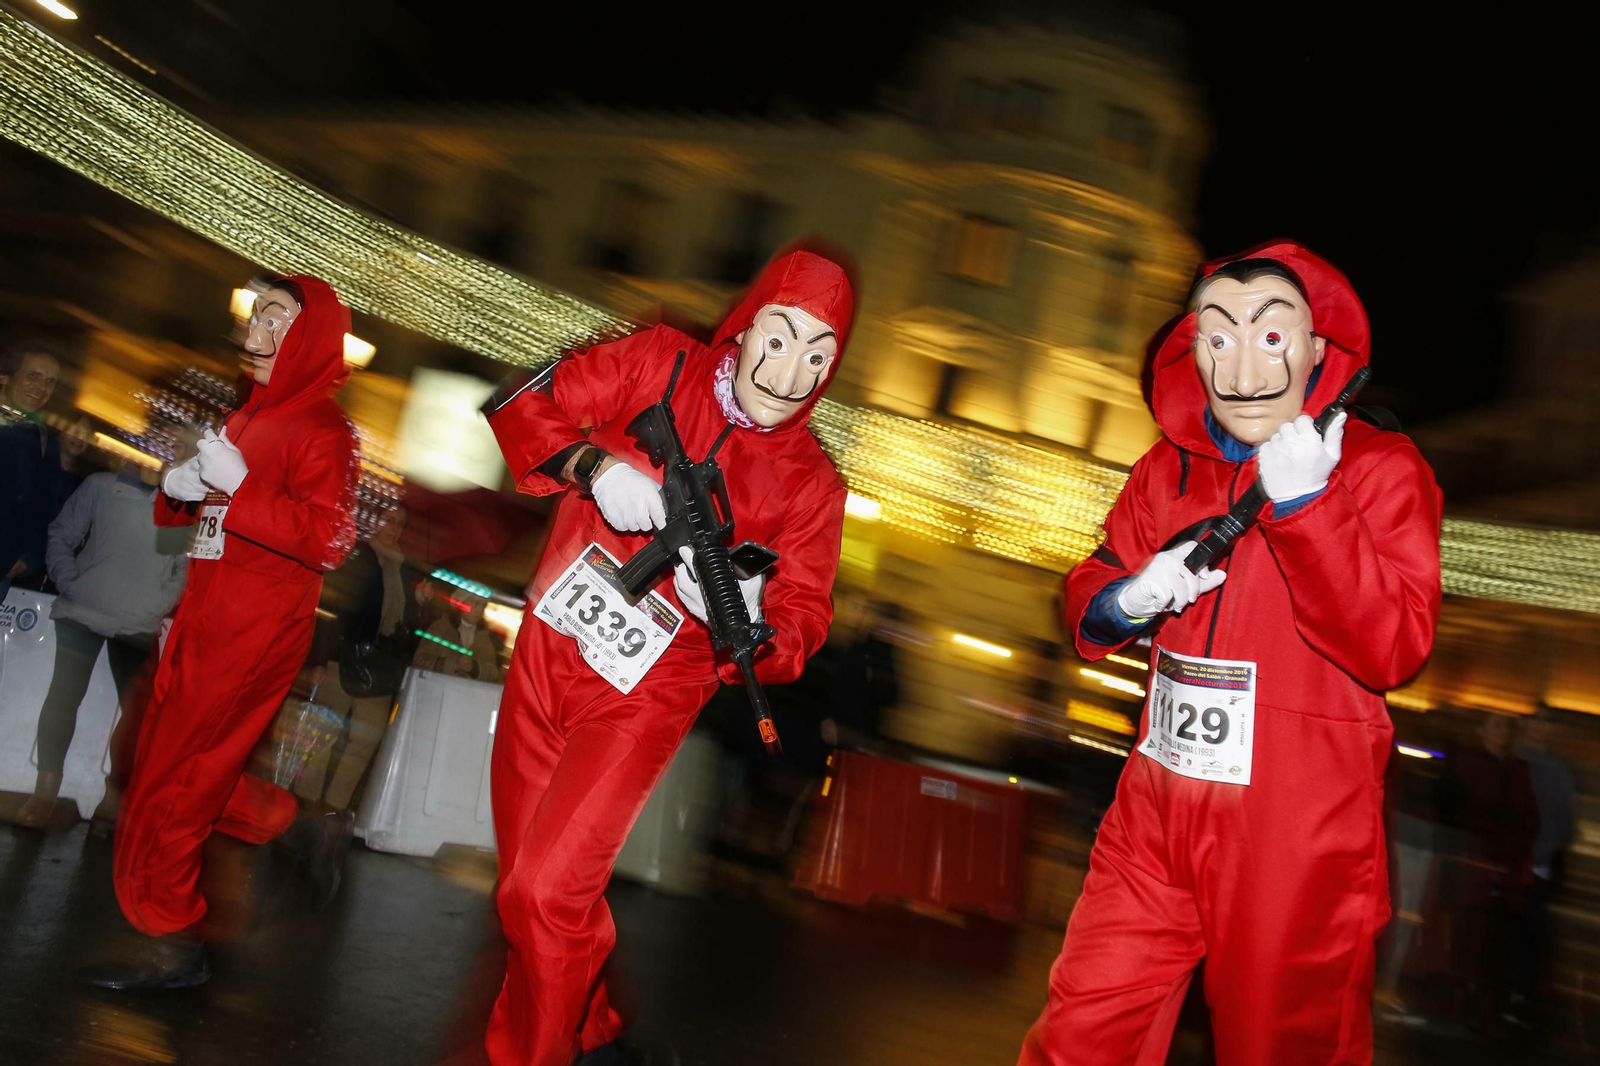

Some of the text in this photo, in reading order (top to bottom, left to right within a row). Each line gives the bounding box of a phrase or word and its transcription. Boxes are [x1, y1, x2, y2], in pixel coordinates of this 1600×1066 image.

[200, 516, 217, 538] 78
[562, 611, 575, 626] PABLO
[572, 620, 585, 635] RUBIO
[566, 582, 646, 658] 1339
[1160, 692, 1230, 746] 1129
